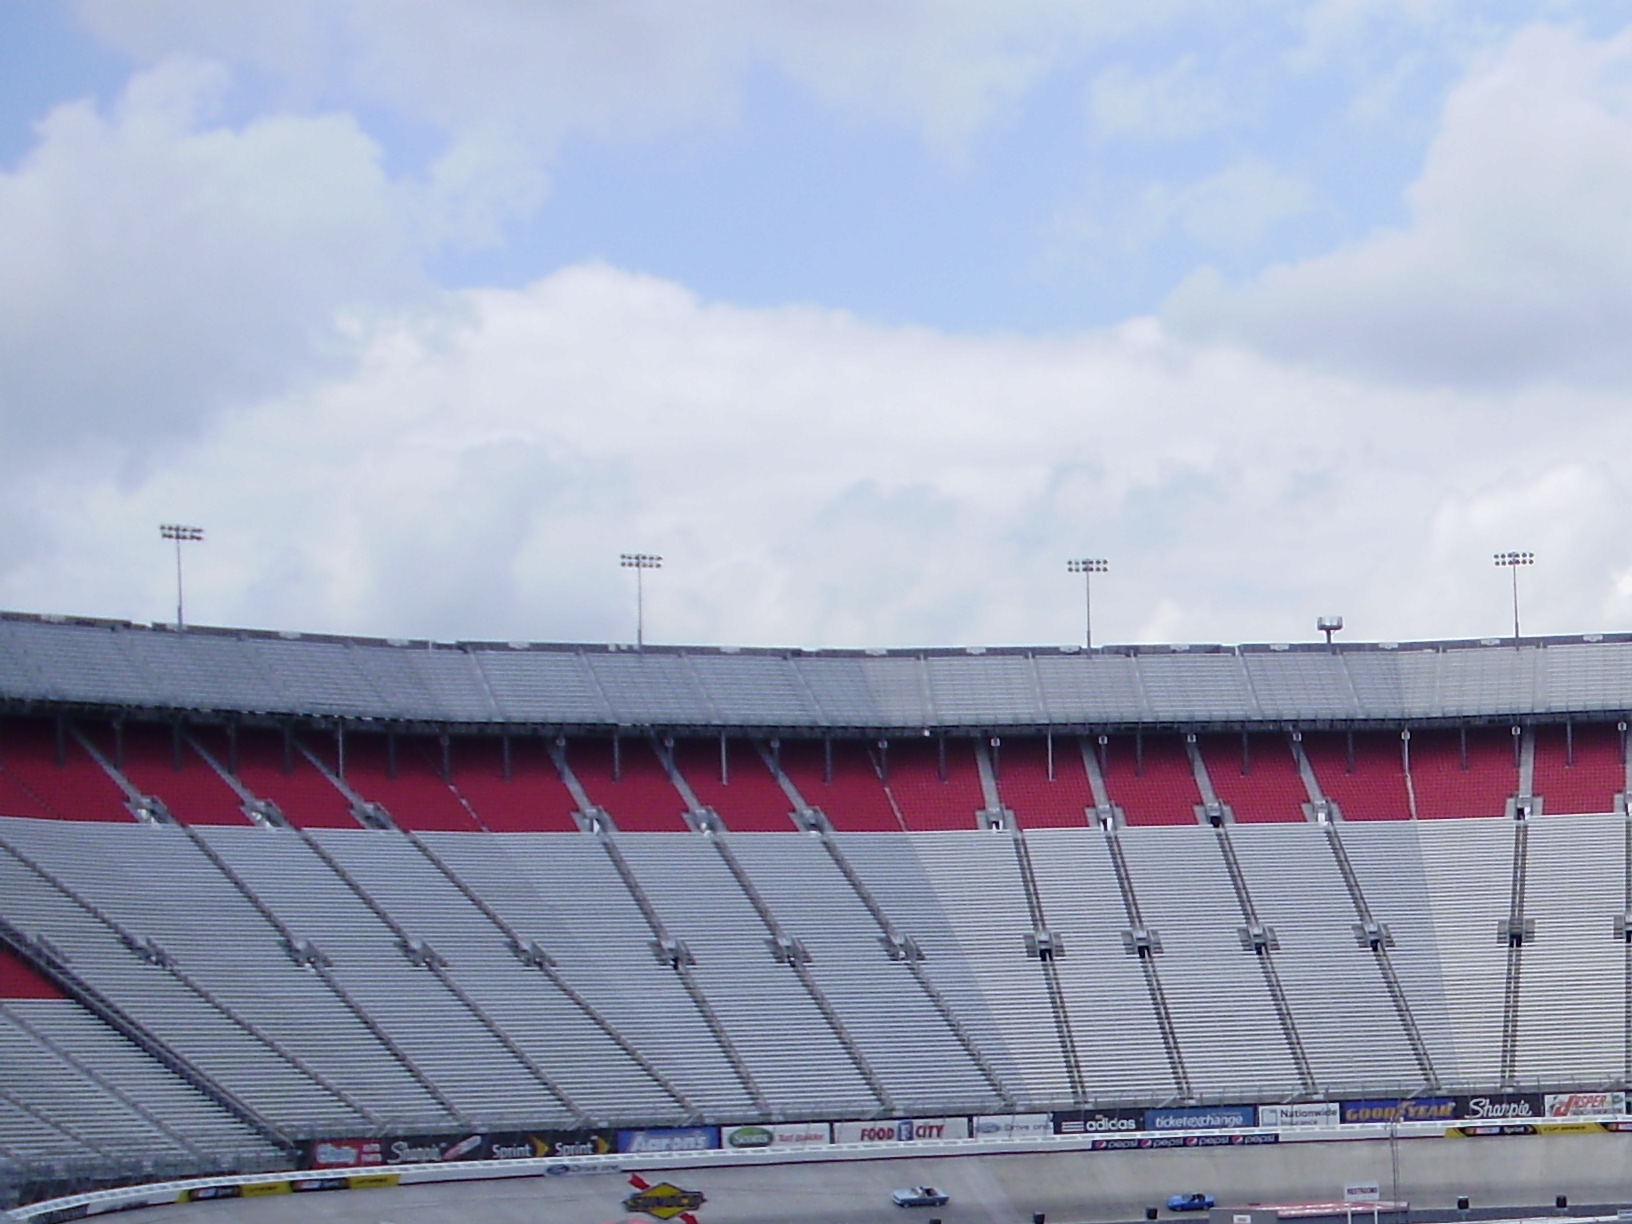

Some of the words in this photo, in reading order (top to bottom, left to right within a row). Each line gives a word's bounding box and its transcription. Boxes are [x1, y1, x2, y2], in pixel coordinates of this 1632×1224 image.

[1280, 1108, 1337, 1119] Nationwide
[1464, 1098, 1533, 1119] Sharpie
[1086, 1118, 1136, 1131] adidas
[1155, 1115, 1244, 1128] ticketexchange
[860, 1127, 895, 1142] FOOD
[915, 1124, 945, 1139] CITY
[1245, 1134, 1276, 1145] pepsi
[1108, 1139, 1138, 1149] pepsi
[1153, 1138, 1184, 1148] pepsi
[1199, 1136, 1229, 1147] pepsi
[492, 1144, 533, 1159] Sprint
[555, 1141, 594, 1157] Sprint
